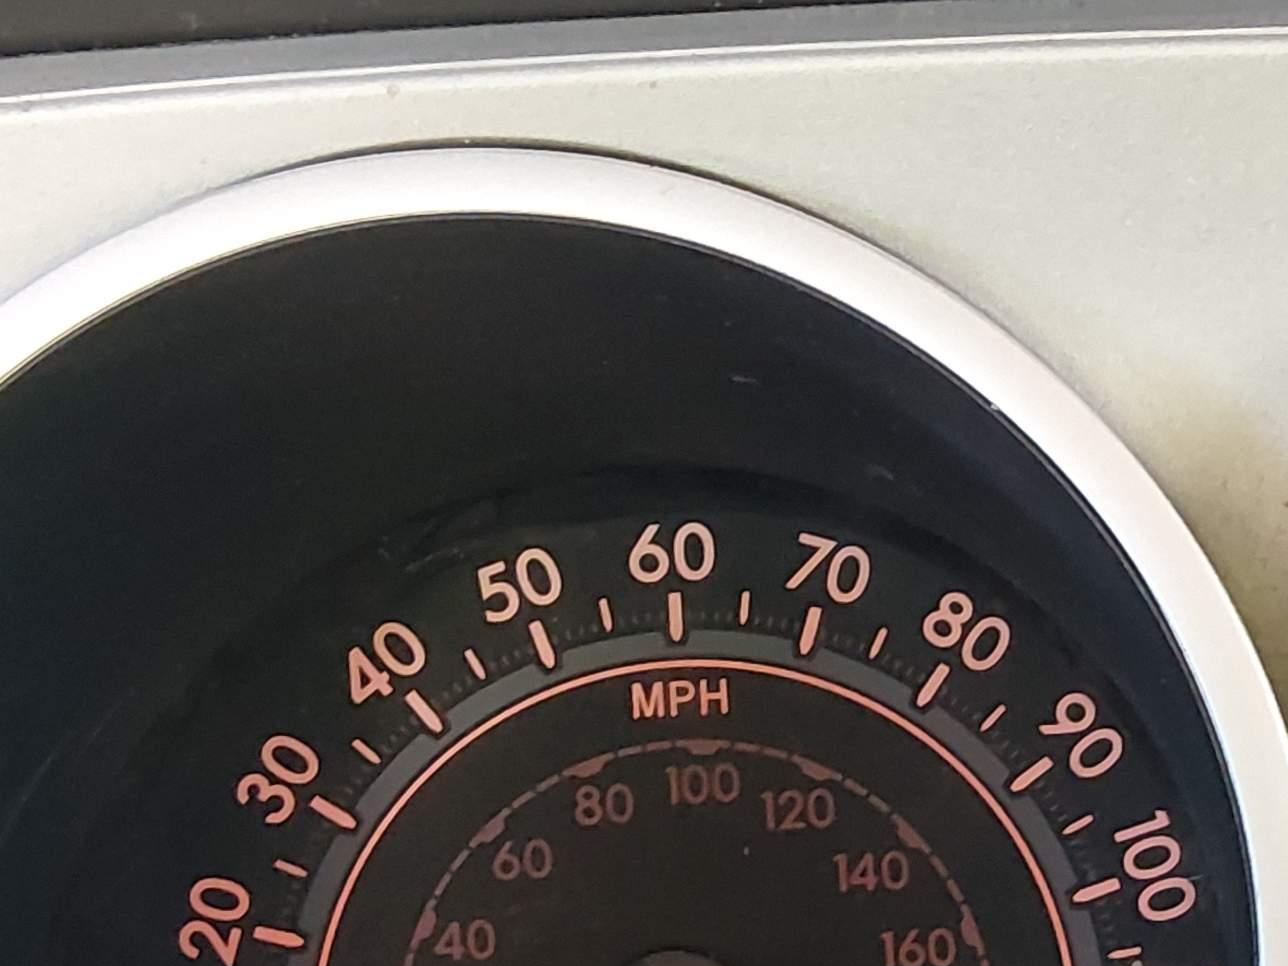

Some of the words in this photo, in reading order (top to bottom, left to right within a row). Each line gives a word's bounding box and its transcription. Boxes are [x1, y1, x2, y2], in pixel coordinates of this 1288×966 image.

[628, 522, 715, 583] 60
[785, 532, 870, 603] 70
[477, 548, 562, 622] 50
[922, 592, 1010, 672] 80
[348, 622, 427, 705] 40
[631, 678, 729, 720] MPH
[1037, 692, 1123, 779] 90
[236, 735, 321, 823] 30
[575, 783, 634, 826] 80
[665, 762, 740, 806] 100
[760, 787, 836, 831] 120
[490, 835, 553, 881] 60
[832, 850, 909, 893] 140
[1112, 809, 1196, 922] 100
[433, 915, 496, 961] 40
